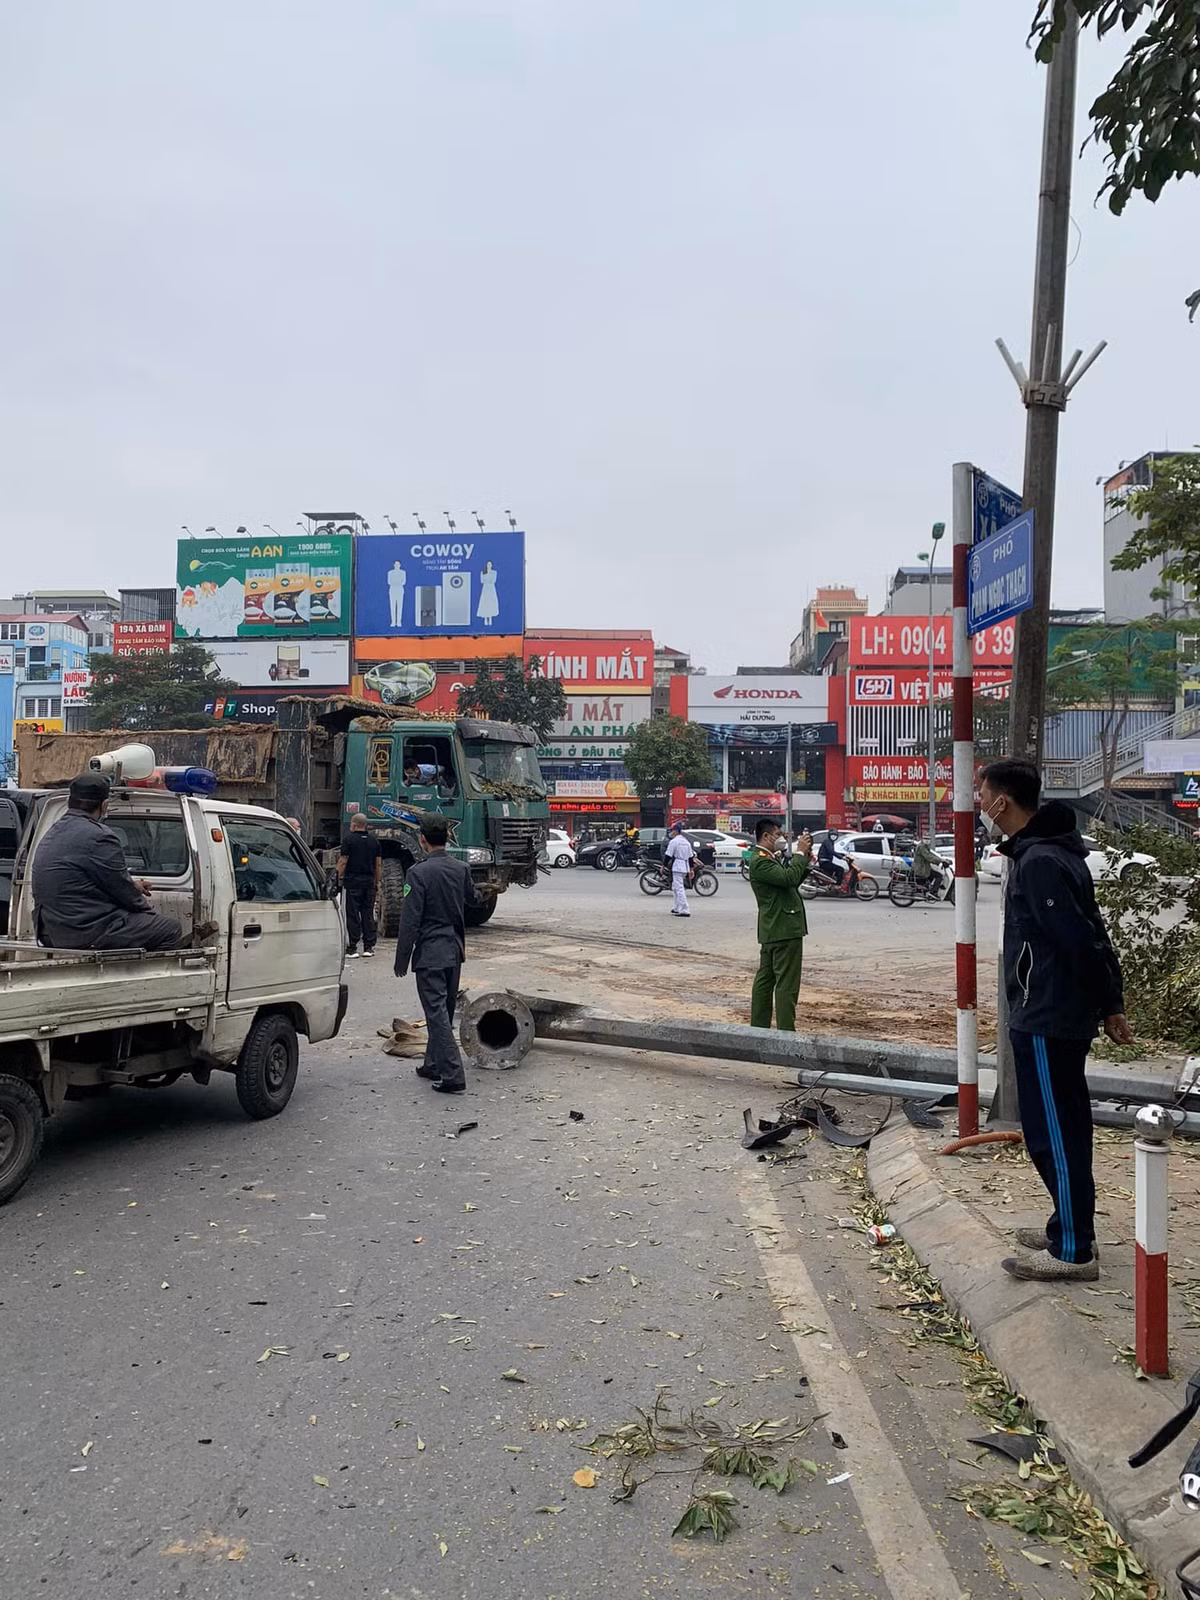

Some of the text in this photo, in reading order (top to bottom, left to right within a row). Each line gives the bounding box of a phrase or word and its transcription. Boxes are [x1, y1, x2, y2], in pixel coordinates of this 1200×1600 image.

[410, 543, 475, 560] coway
[993, 532, 1014, 563] PHỐ
[1005, 564, 1027, 604] THẠCH
[119, 625, 134, 634] 194
[861, 626, 894, 656] LH:
[900, 625, 946, 656] 0904
[595, 647, 648, 680] MẮT
[733, 689, 802, 699] HONDA
[900, 678, 930, 704] VIỆT
[582, 696, 625, 722] MẮT
[569, 722, 637, 737] AN PHÁ
[862, 760, 879, 780] BẢO
[881, 761, 903, 780] HÀNH
[907, 760, 924, 780] BẢO
[872, 788, 899, 801] KHÁCH
[900, 790, 919, 801] THAY
